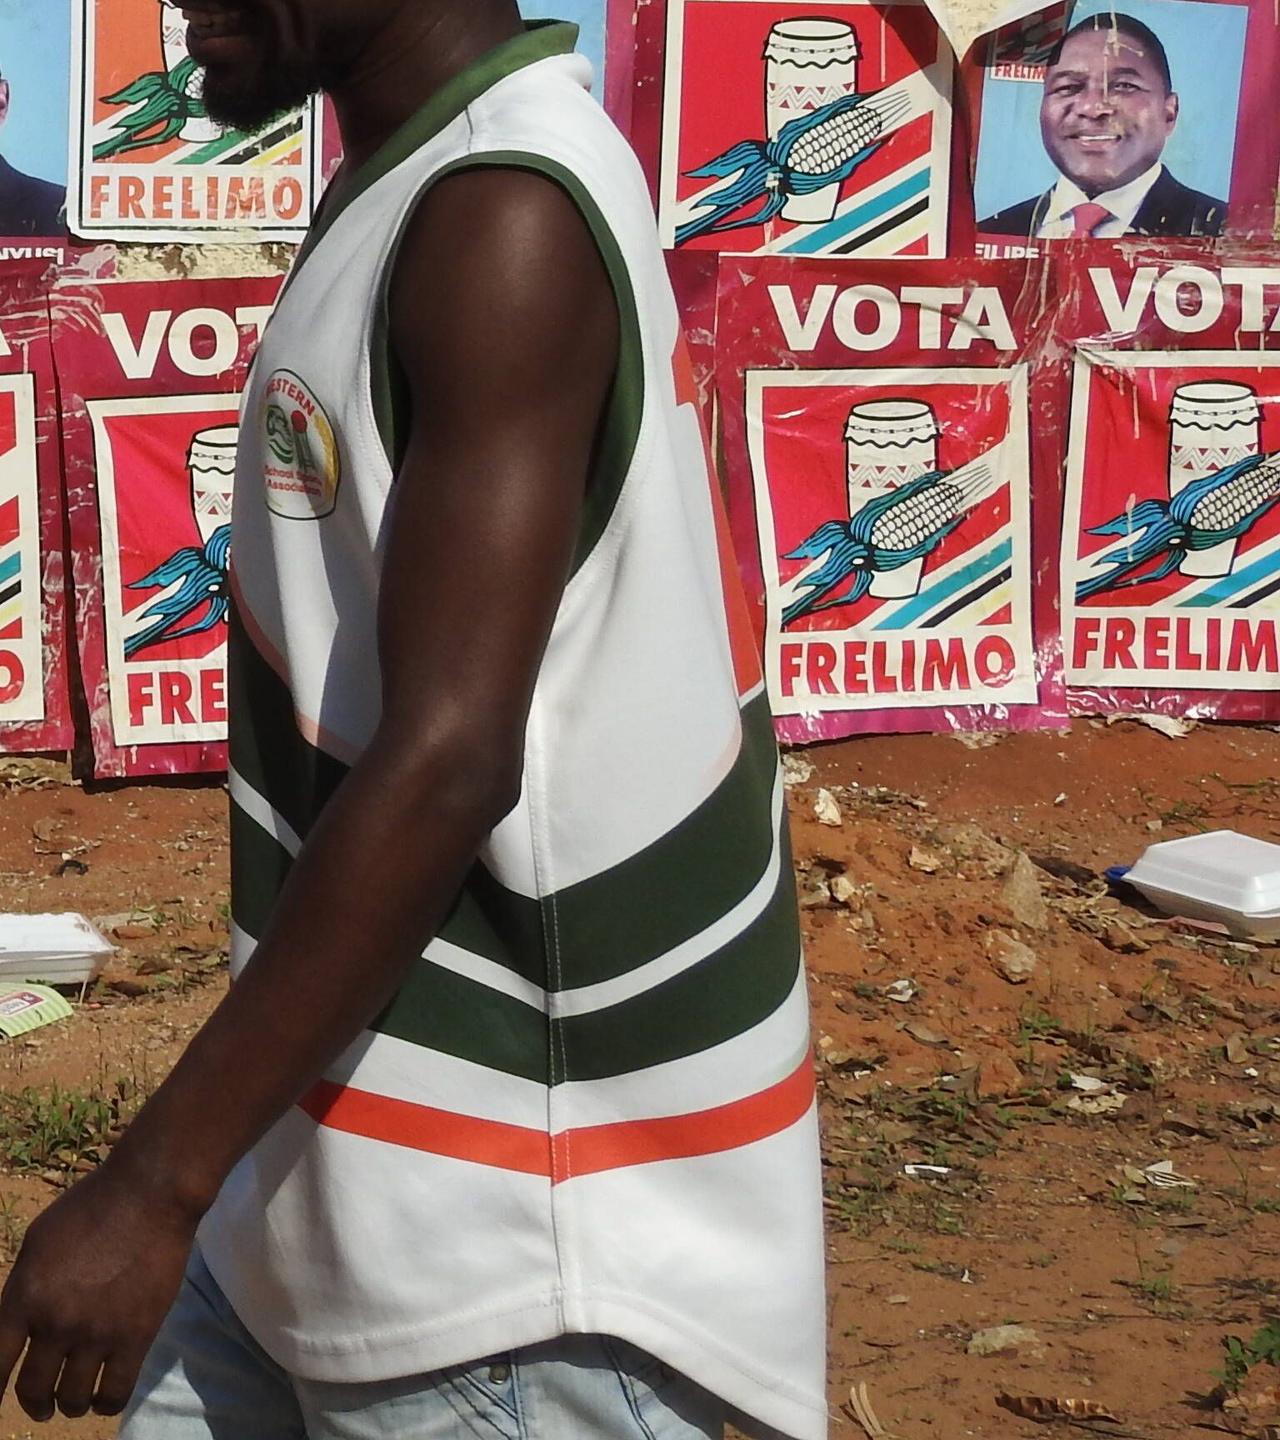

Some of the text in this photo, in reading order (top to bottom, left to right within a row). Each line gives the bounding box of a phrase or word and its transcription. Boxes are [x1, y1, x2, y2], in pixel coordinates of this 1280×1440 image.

[91, 173, 303, 222] FRELIMO
[767, 284, 1018, 351] VOTA
[780, 634, 1017, 698] FRELIMO
